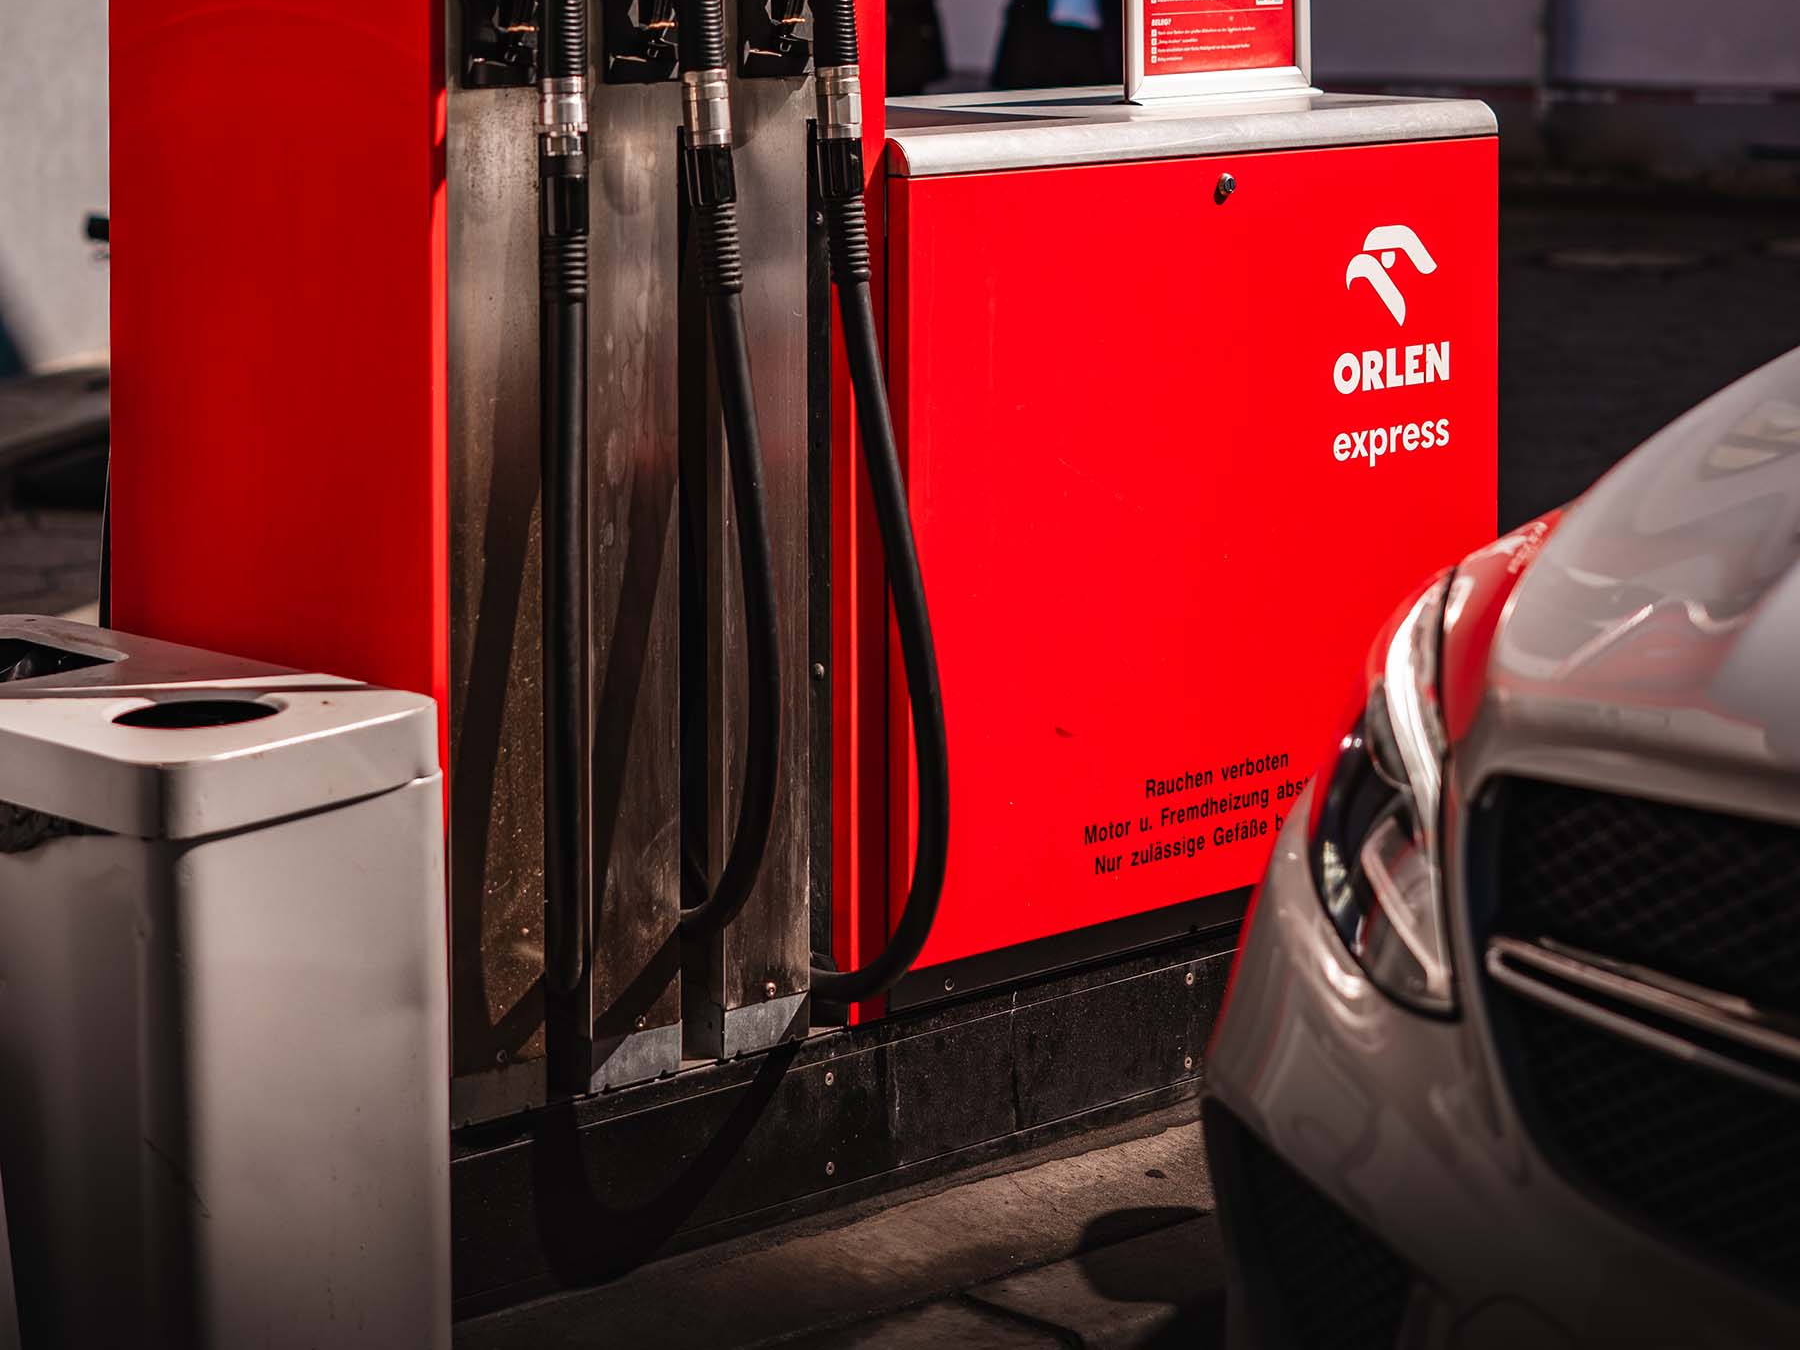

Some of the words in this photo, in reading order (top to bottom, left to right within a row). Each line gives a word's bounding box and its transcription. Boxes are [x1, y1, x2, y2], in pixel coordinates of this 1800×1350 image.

[1333, 340, 1450, 395] ORLEN
[1333, 418, 1450, 468] express
[1145, 768, 1213, 799] Rauchen
[1221, 753, 1289, 782] verboten
[1084, 819, 1131, 846] Motor
[1139, 818, 1153, 833] u.
[1160, 788, 1269, 827] Fremdheizung
[1095, 855, 1123, 876] Nur
[1130, 834, 1206, 867] zulässige
[1213, 820, 1268, 847] Gefäße
